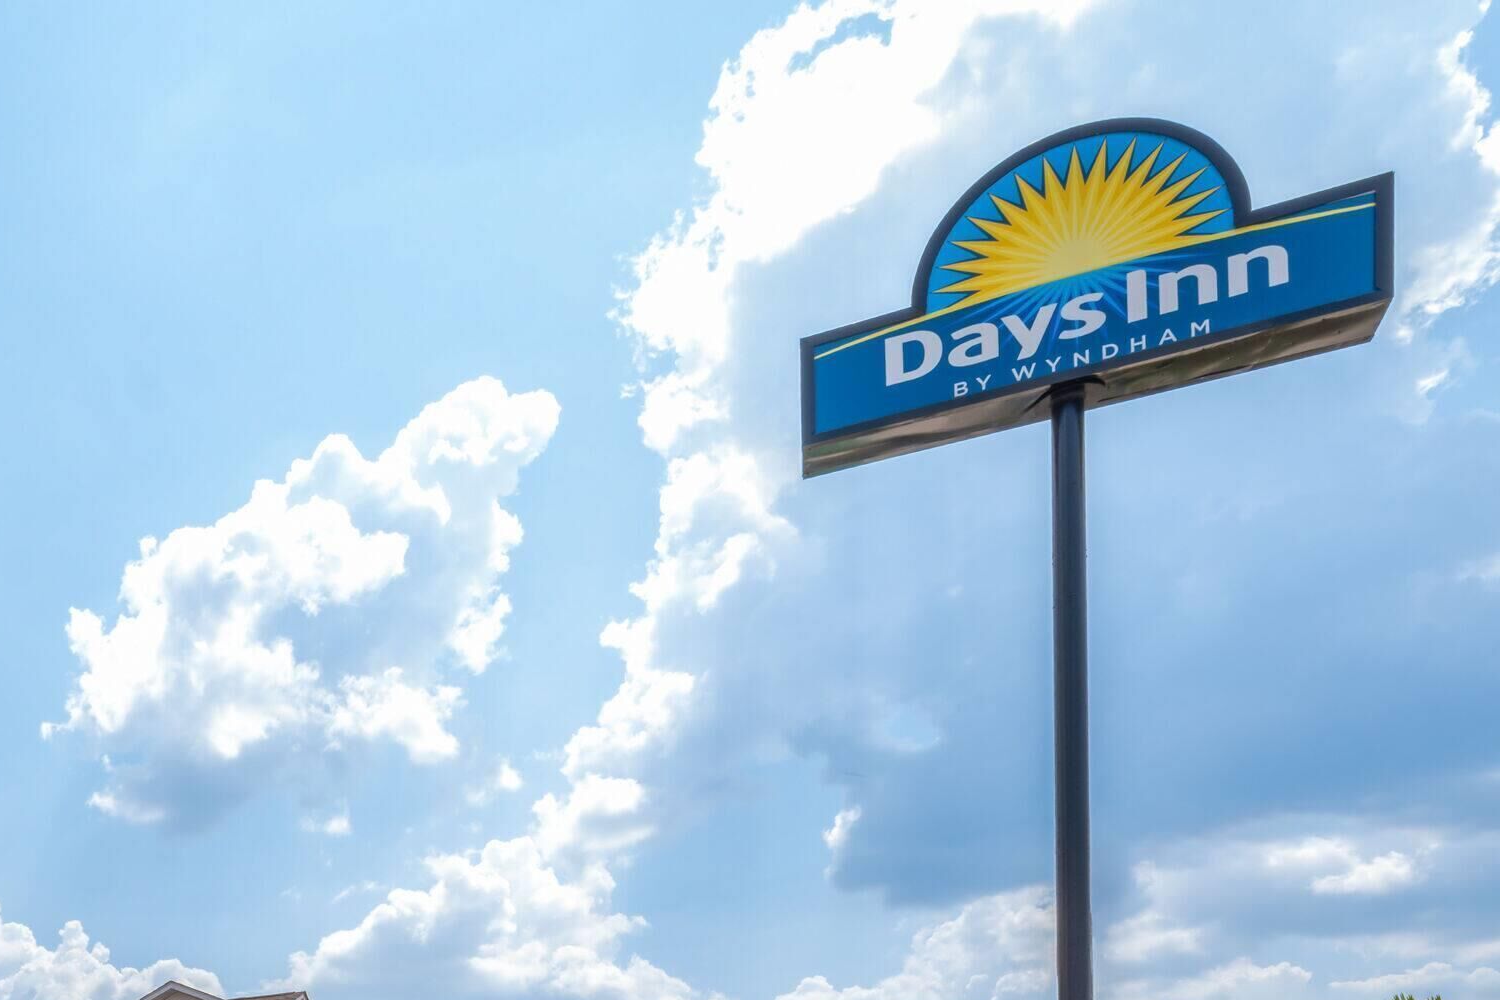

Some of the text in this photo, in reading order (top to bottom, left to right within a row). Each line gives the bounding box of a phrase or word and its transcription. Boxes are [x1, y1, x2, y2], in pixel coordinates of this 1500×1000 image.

[884, 245, 1289, 387] Days Inn
[953, 319, 1210, 397] BY WYNDHAM
